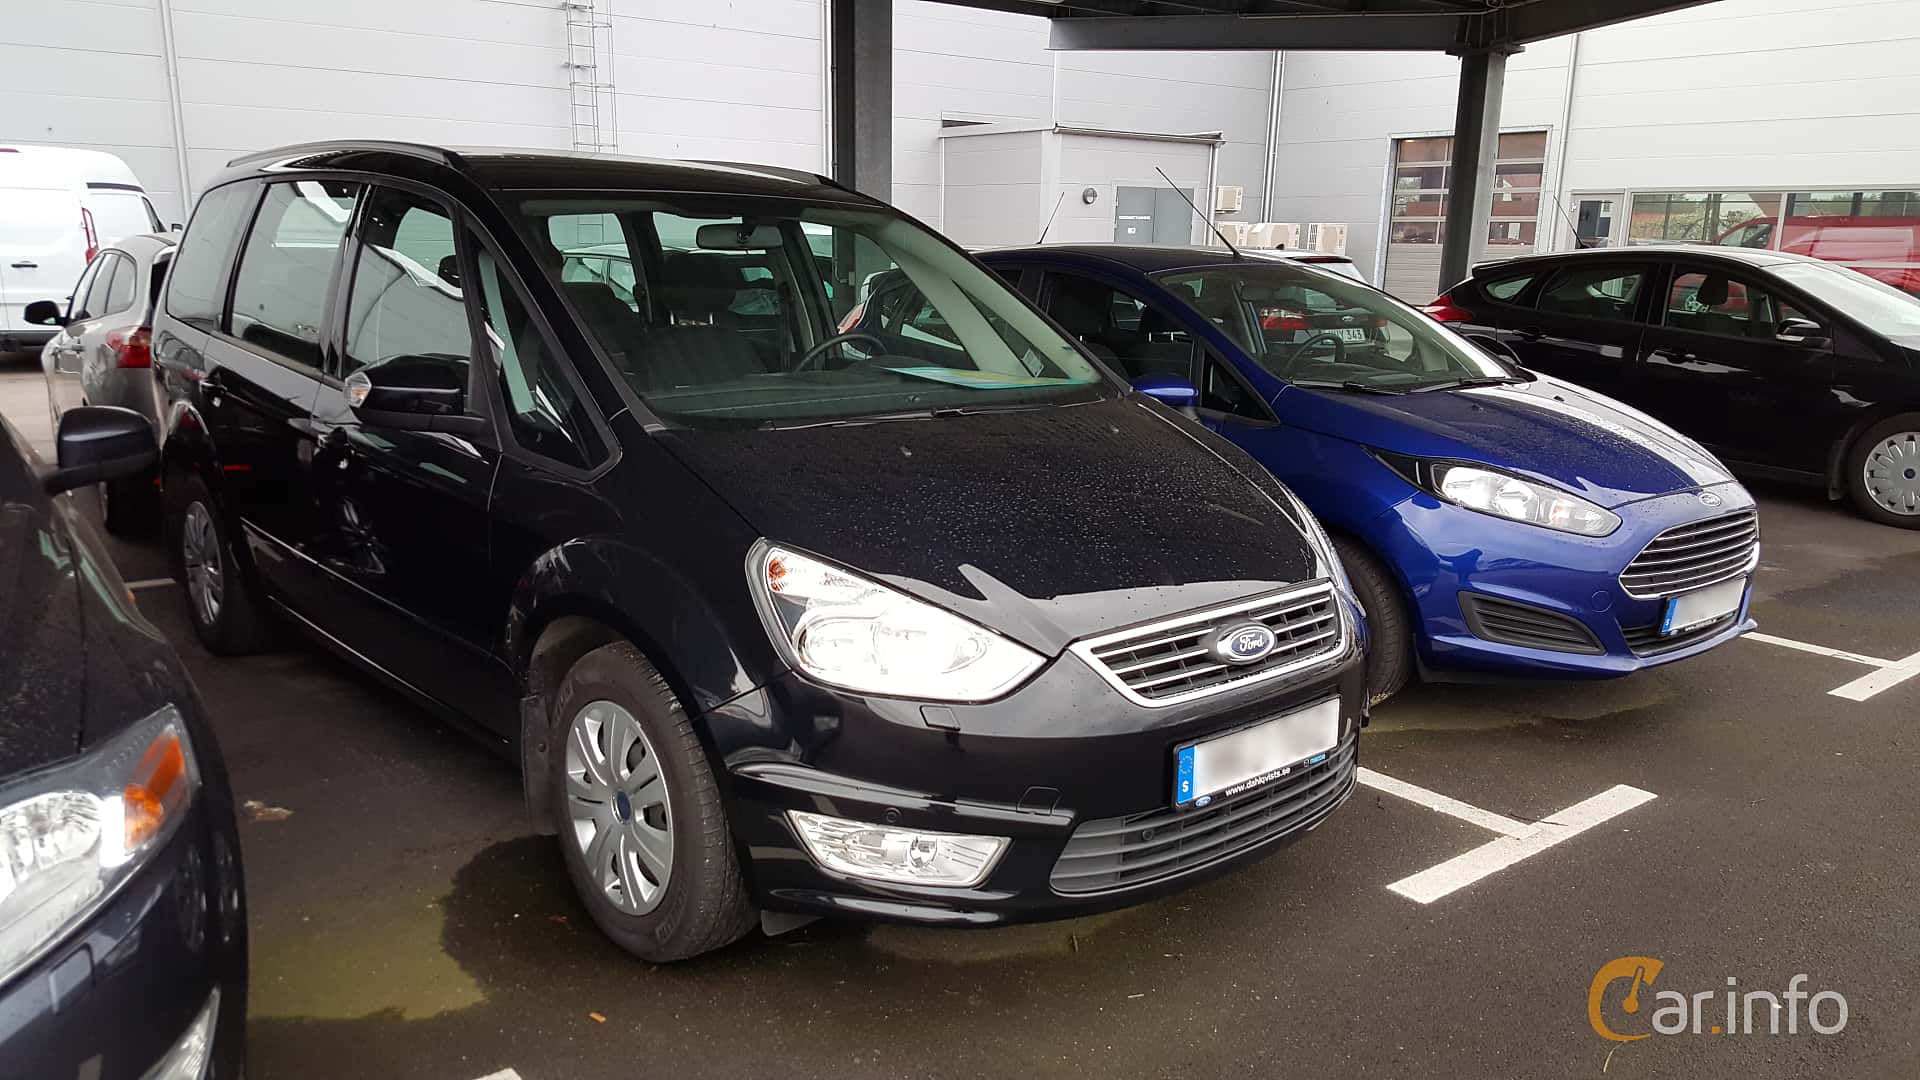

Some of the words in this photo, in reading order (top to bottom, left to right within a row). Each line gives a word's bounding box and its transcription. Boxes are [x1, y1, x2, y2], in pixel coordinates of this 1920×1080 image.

[1239, 633, 1265, 652] Ford
[1182, 780, 1190, 793] S
[1225, 767, 1291, 797] www.dahlqvists.se
